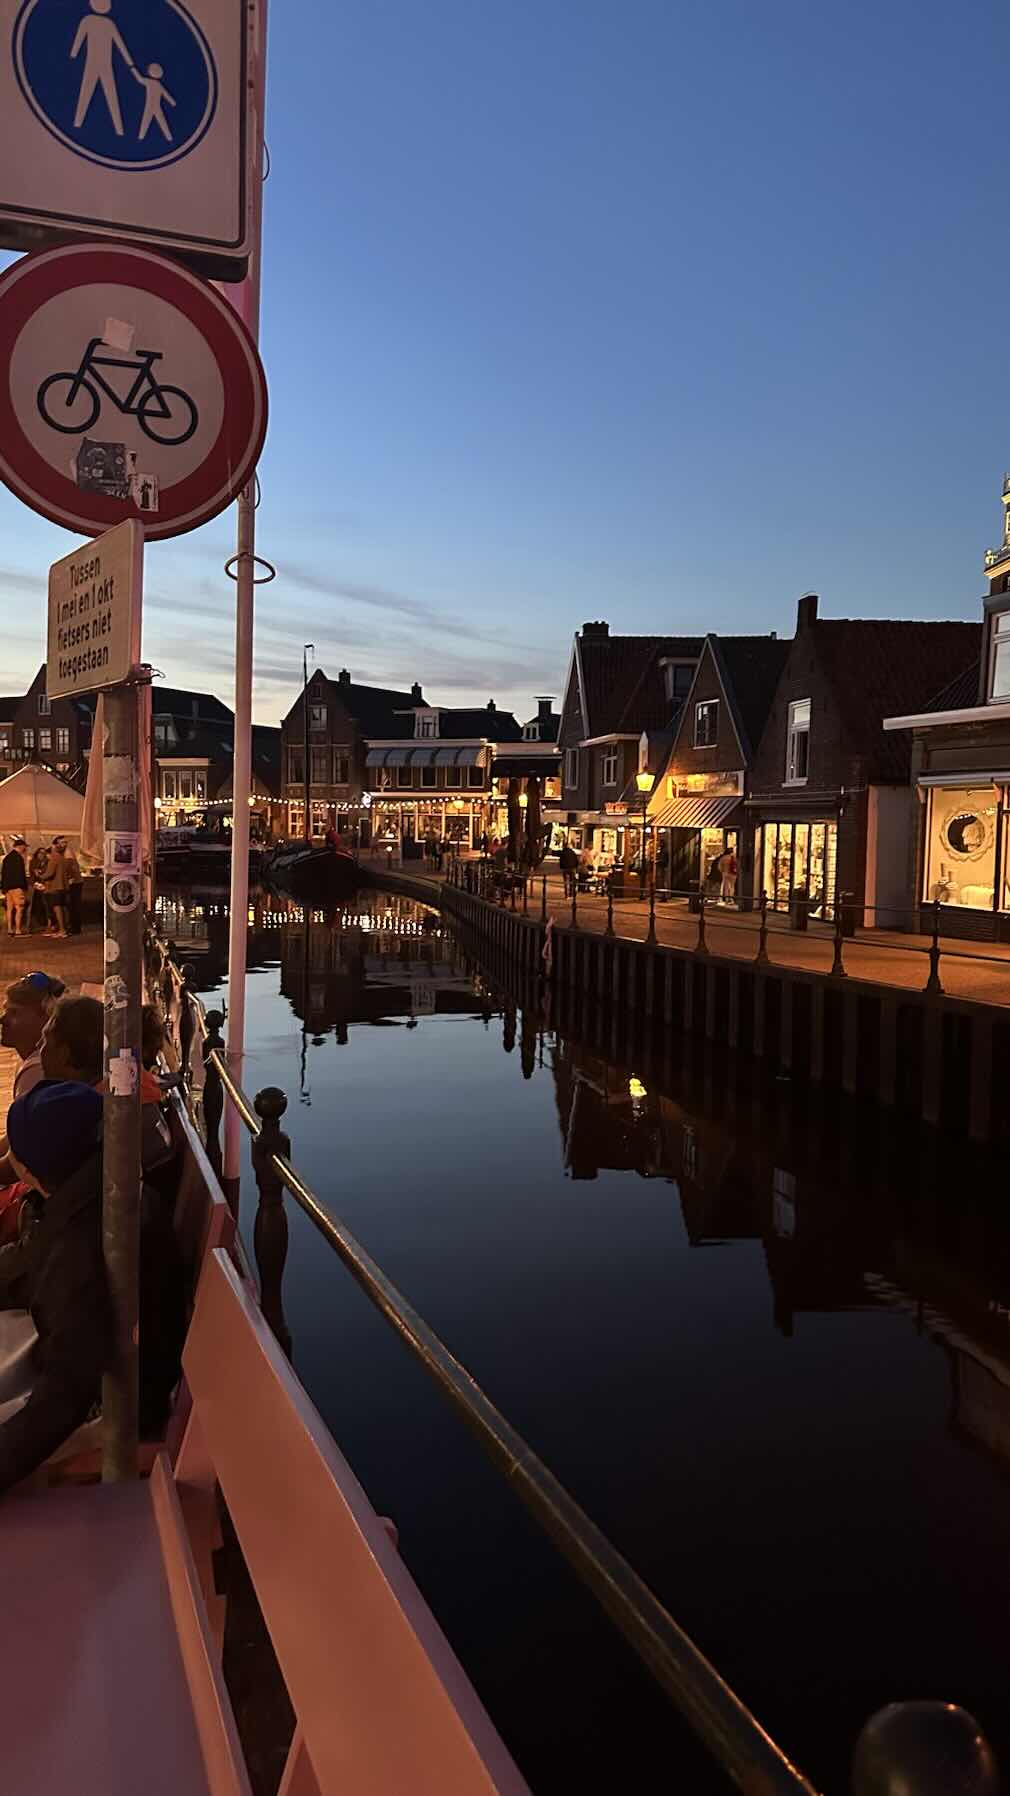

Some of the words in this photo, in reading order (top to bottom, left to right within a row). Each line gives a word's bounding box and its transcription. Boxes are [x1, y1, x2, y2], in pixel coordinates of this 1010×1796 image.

[70, 557, 100, 589] Tussen
[62, 593, 77, 623] mei
[79, 592, 89, 614] en
[98, 575, 114, 605] okt
[58, 622, 90, 652] fietsers
[92, 608, 111, 639] niet
[59, 646, 108, 682] toegestaan
